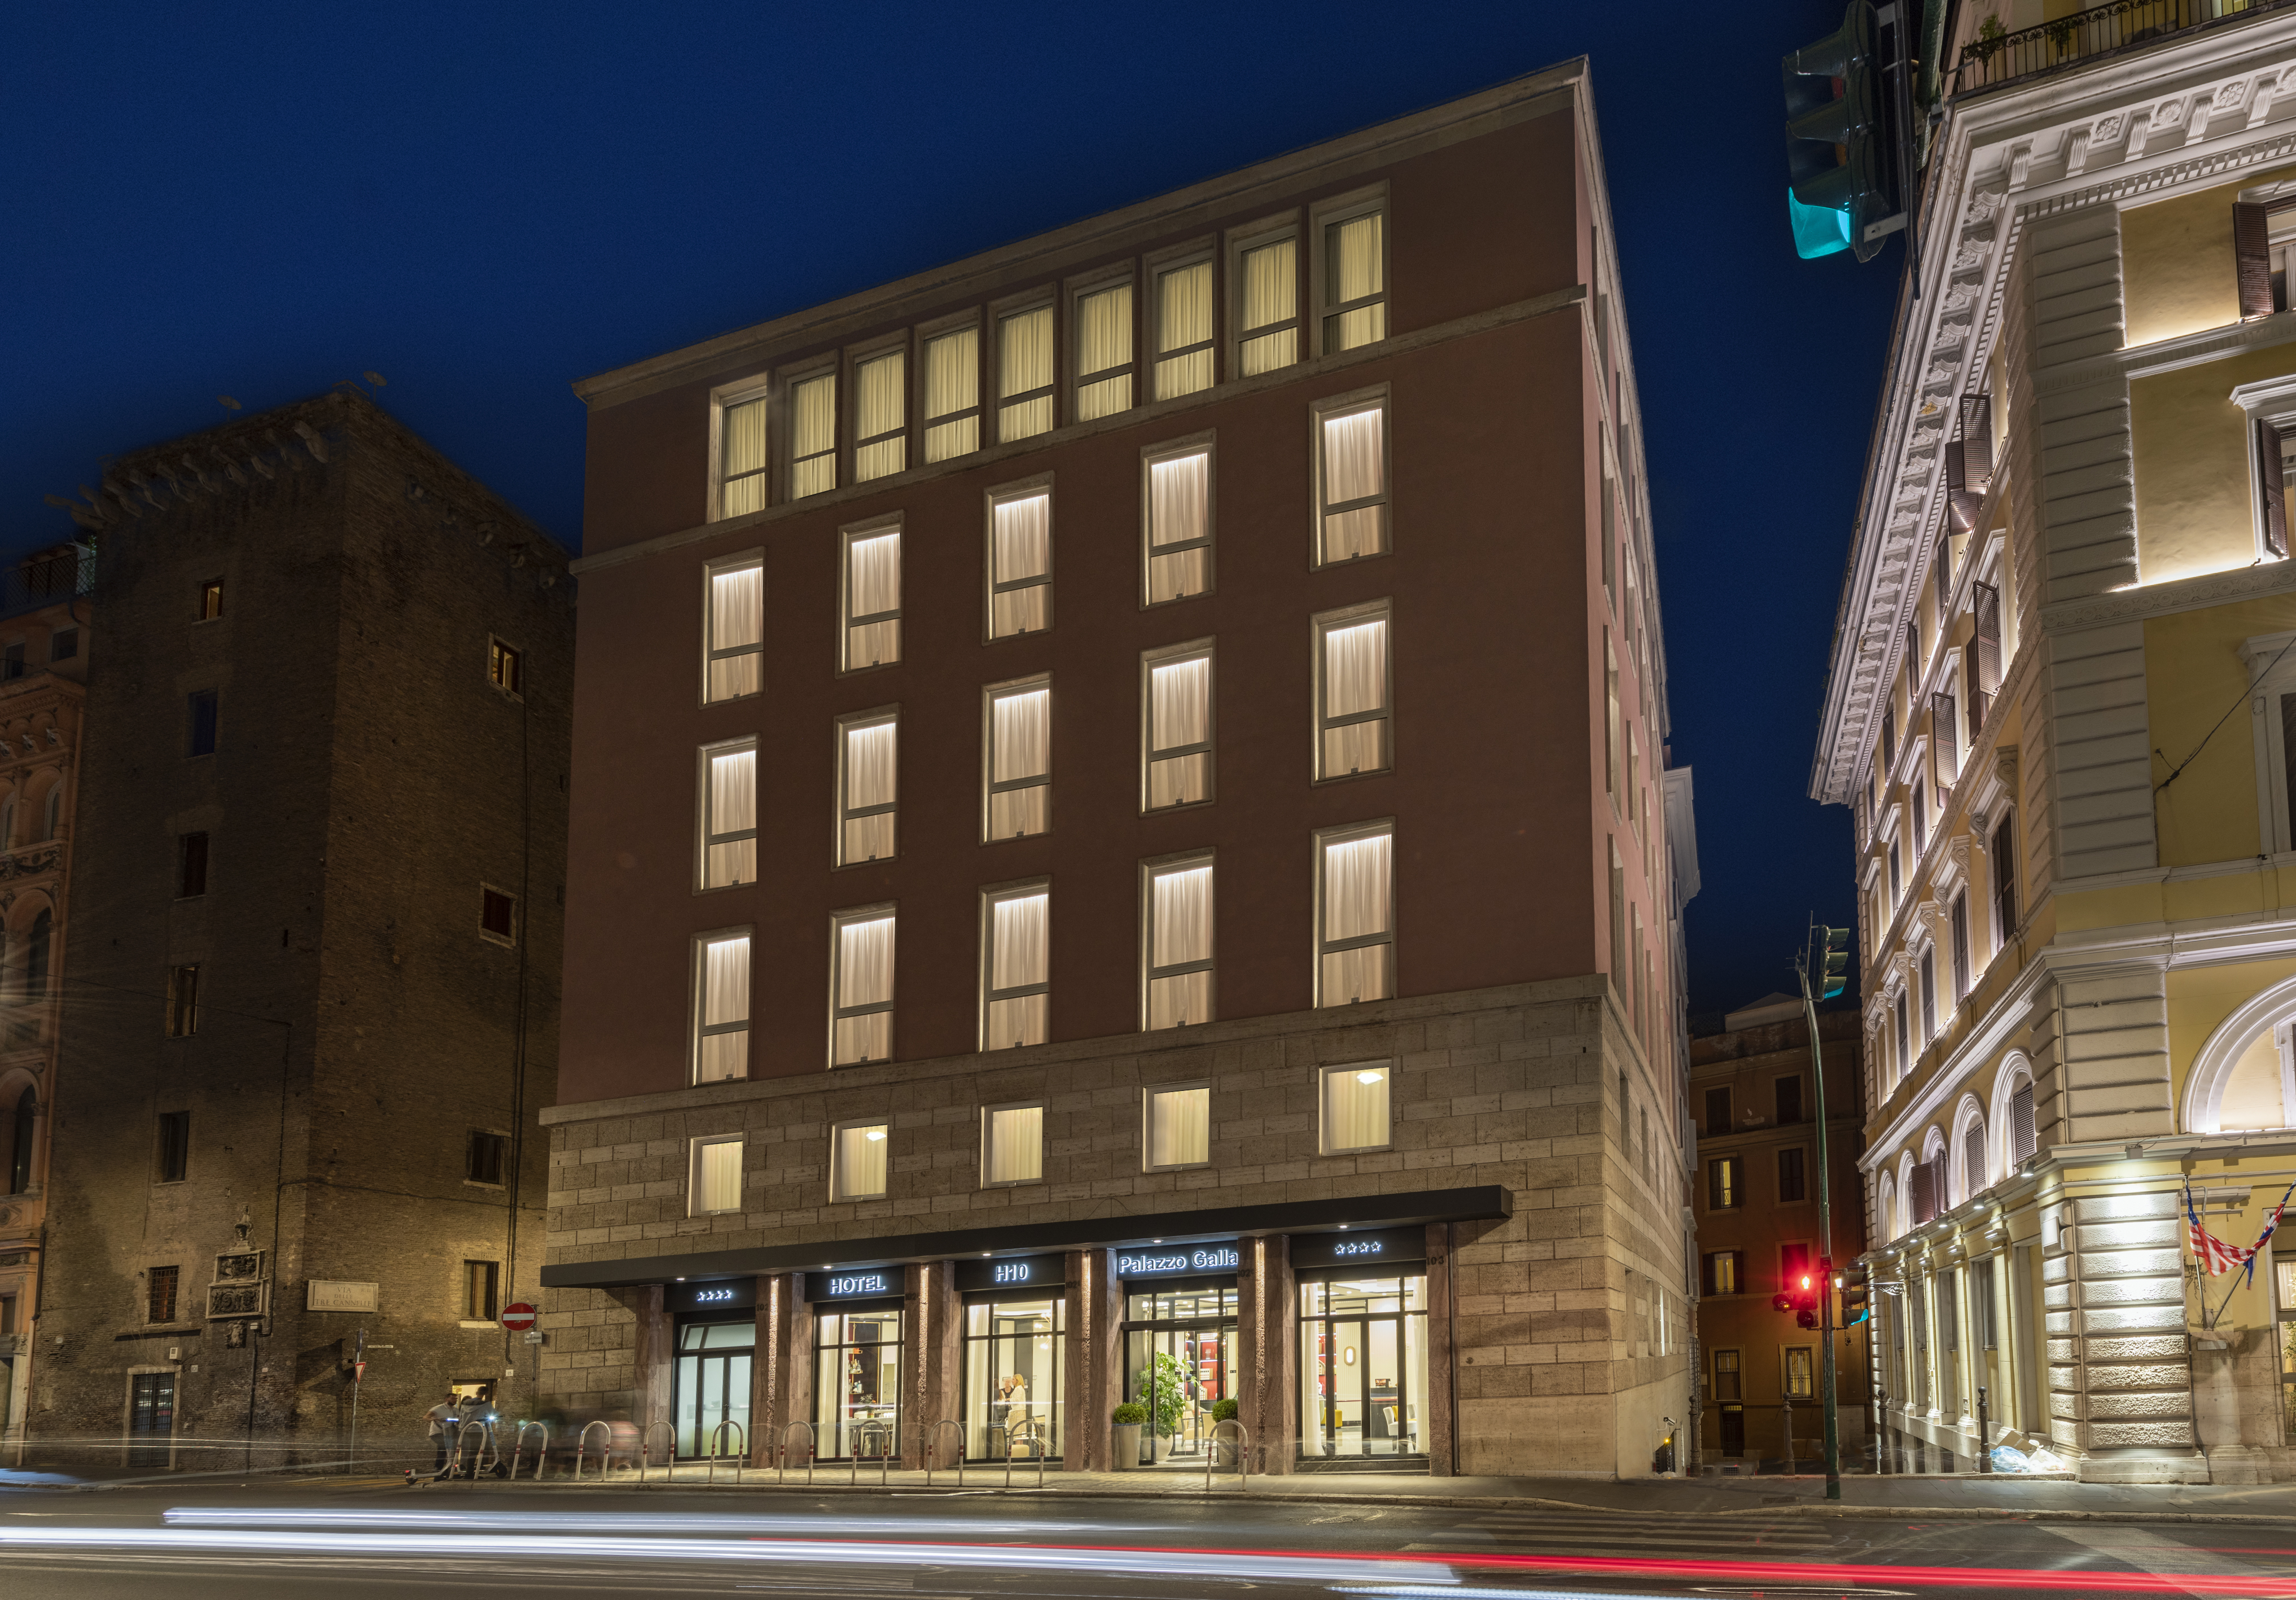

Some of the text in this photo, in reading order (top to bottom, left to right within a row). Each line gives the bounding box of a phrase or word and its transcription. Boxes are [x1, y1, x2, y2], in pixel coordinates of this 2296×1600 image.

[1119, 1249, 1238, 1273] Palazzo Galla
[1427, 1255, 1444, 1265] 103
[996, 1264, 1028, 1281] H10
[830, 1275, 886, 1294] HOTEL
